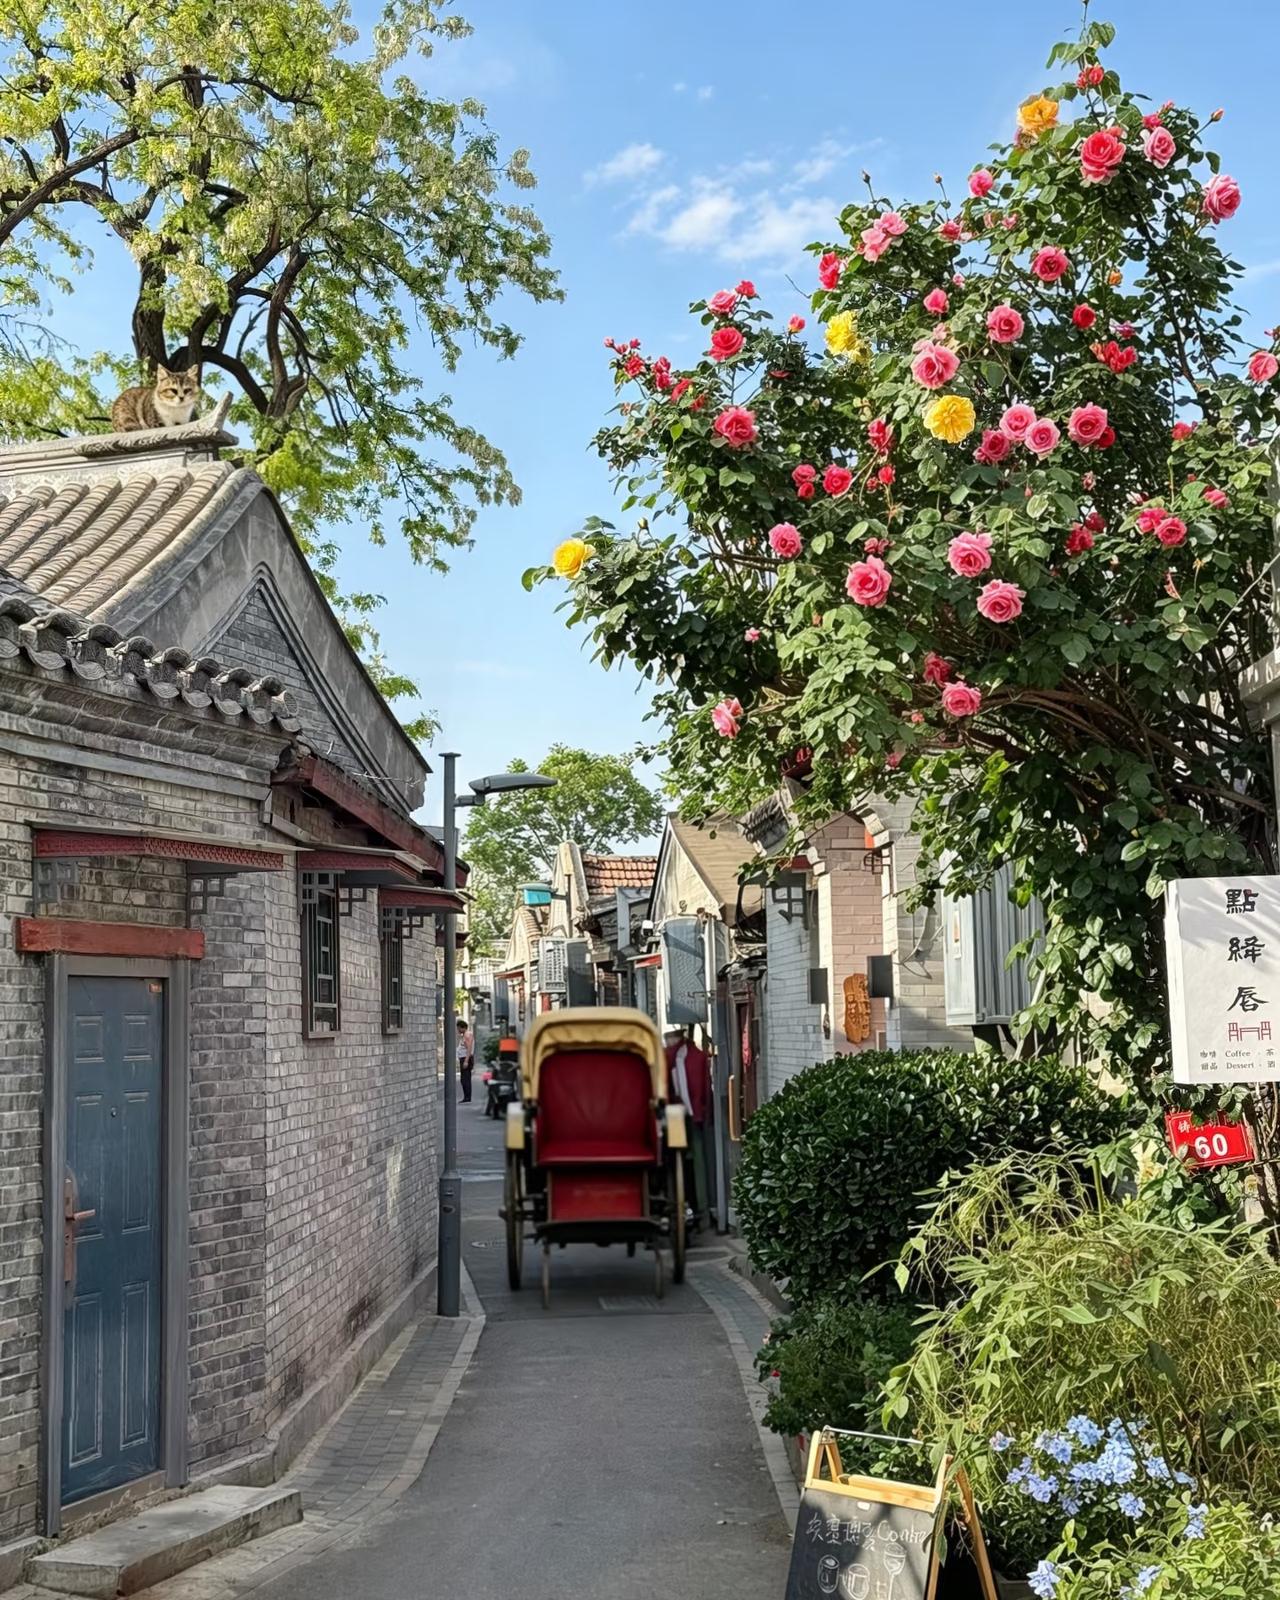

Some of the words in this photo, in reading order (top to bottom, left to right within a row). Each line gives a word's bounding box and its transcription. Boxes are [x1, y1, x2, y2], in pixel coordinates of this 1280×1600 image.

[1225, 1050, 1251, 1058] Coffee
[1226, 1062, 1254, 1070] Dessert
[1194, 1133, 1228, 1159] 60
